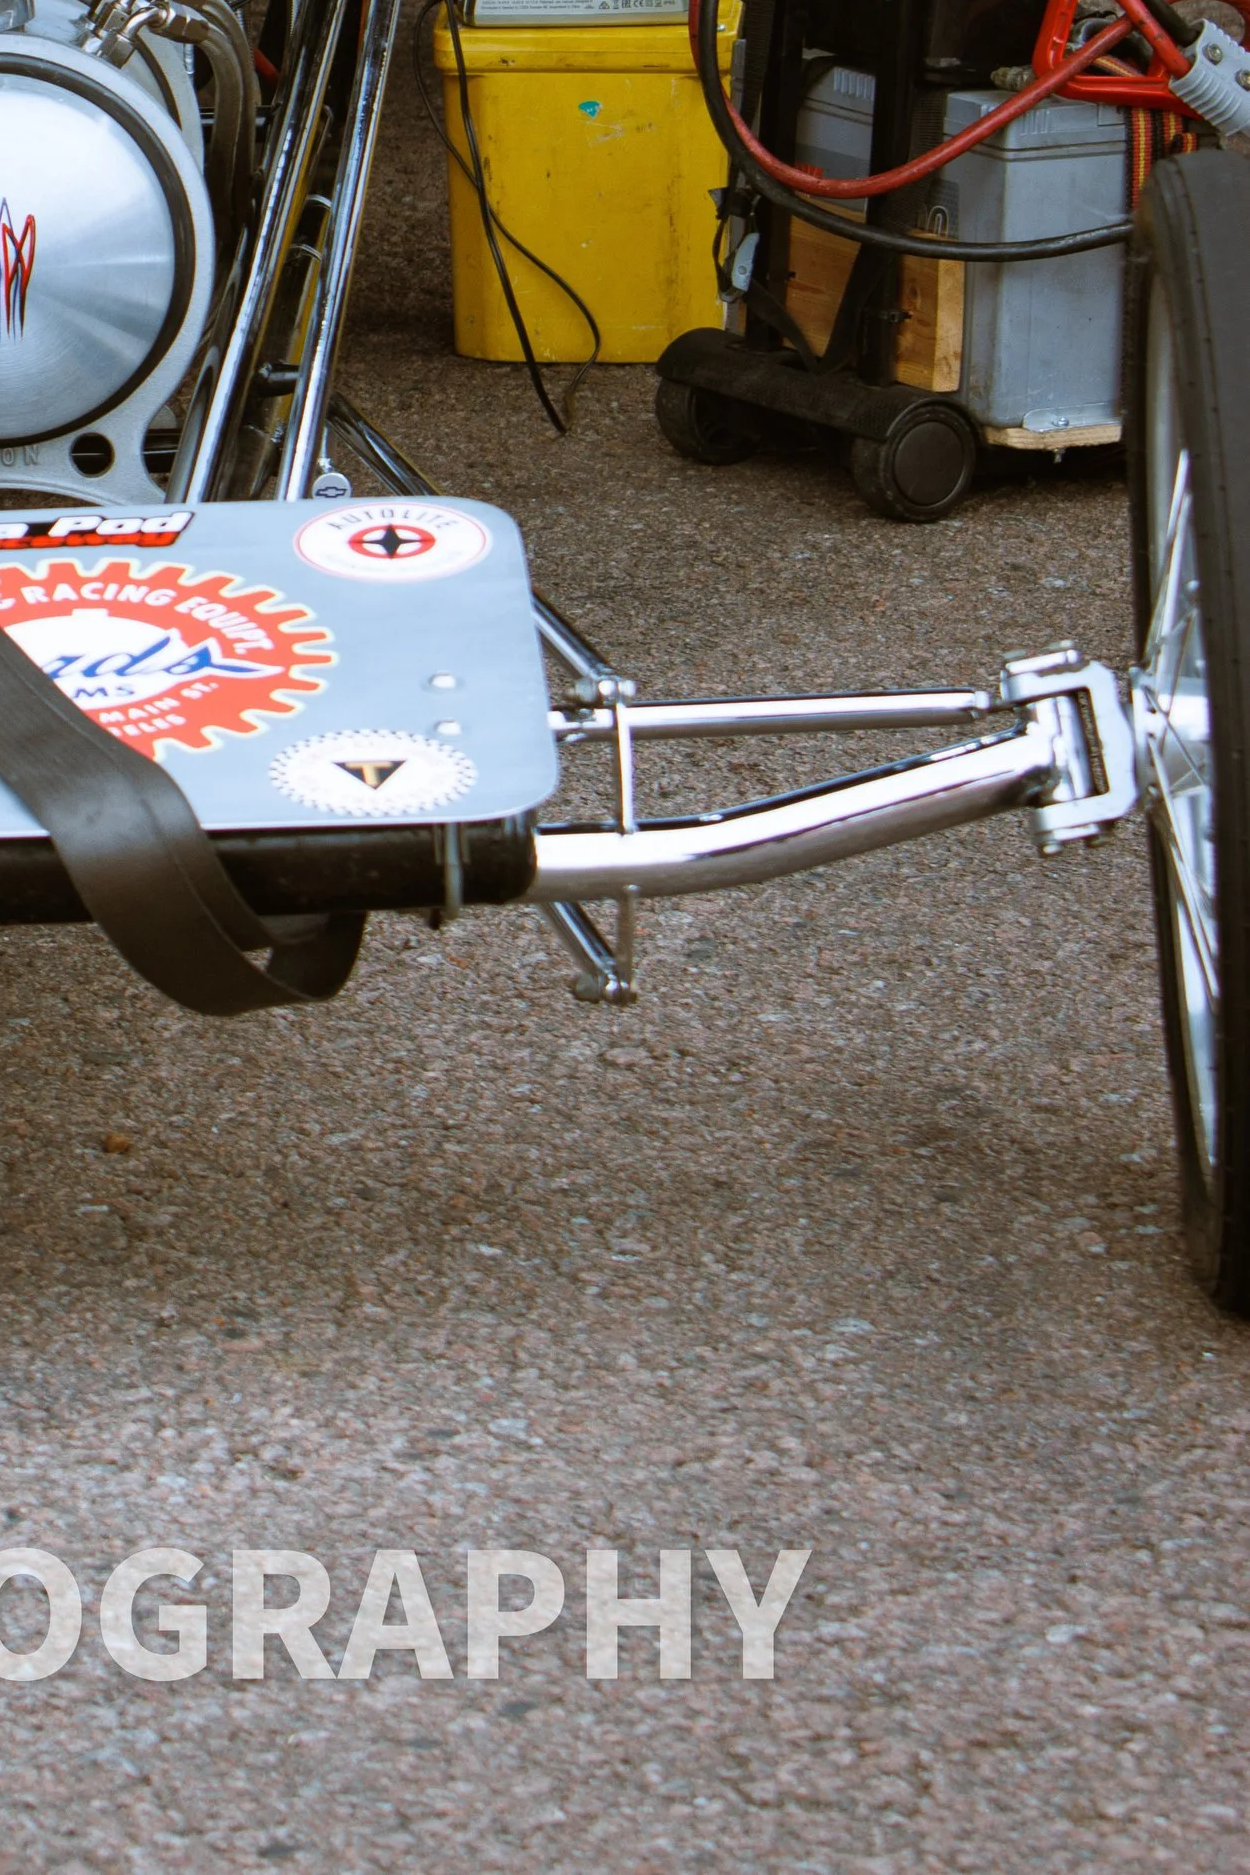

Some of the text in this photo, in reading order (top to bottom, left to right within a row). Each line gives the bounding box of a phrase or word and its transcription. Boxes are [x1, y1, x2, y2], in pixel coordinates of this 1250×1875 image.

[48, 511, 195, 537] Pod
[327, 508, 458, 531] AUTOLITE
[21, 582, 177, 606] RACING
[99, 697, 181, 723] MAIN
